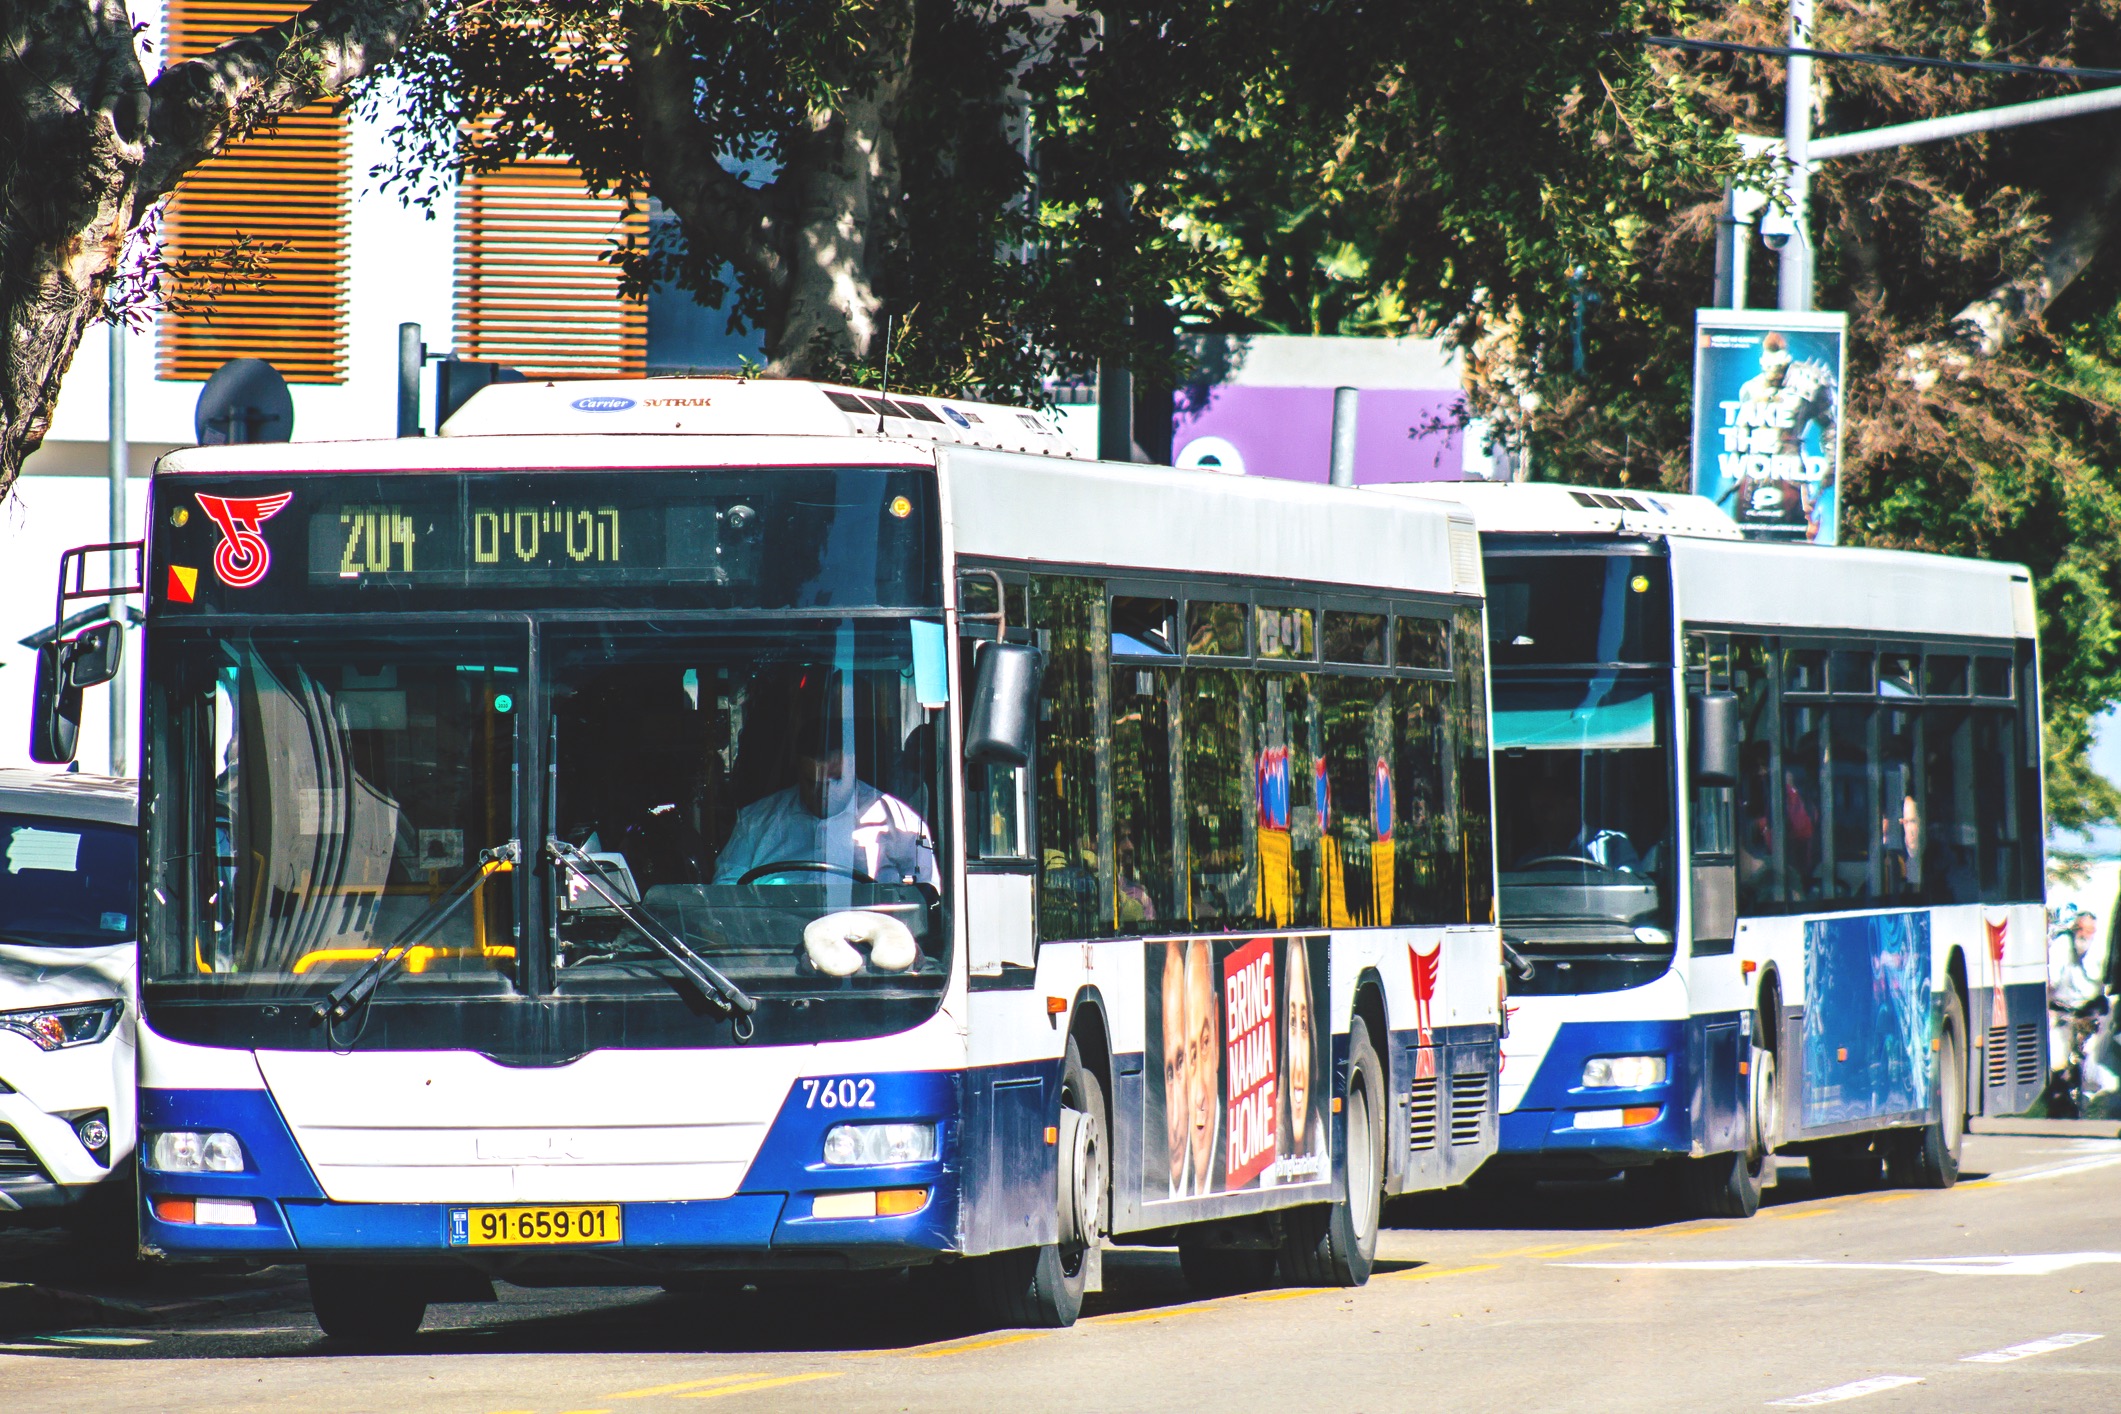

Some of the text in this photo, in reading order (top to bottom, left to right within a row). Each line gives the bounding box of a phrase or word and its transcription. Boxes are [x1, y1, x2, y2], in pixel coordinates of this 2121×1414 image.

[579, 398, 712, 408] Carrier SUTRAK
[1719, 400, 1796, 428] TAKE
[1718, 427, 1779, 454] THE
[1718, 454, 1829, 481] WORLD
[475, 507, 619, 563] הטייסים
[1227, 951, 1272, 1043] BRING
[1229, 1021, 1274, 1101] NAAMA
[802, 1078, 876, 1109] 7602
[1229, 1080, 1275, 1174] HOME
[456, 1220, 466, 1235] IL
